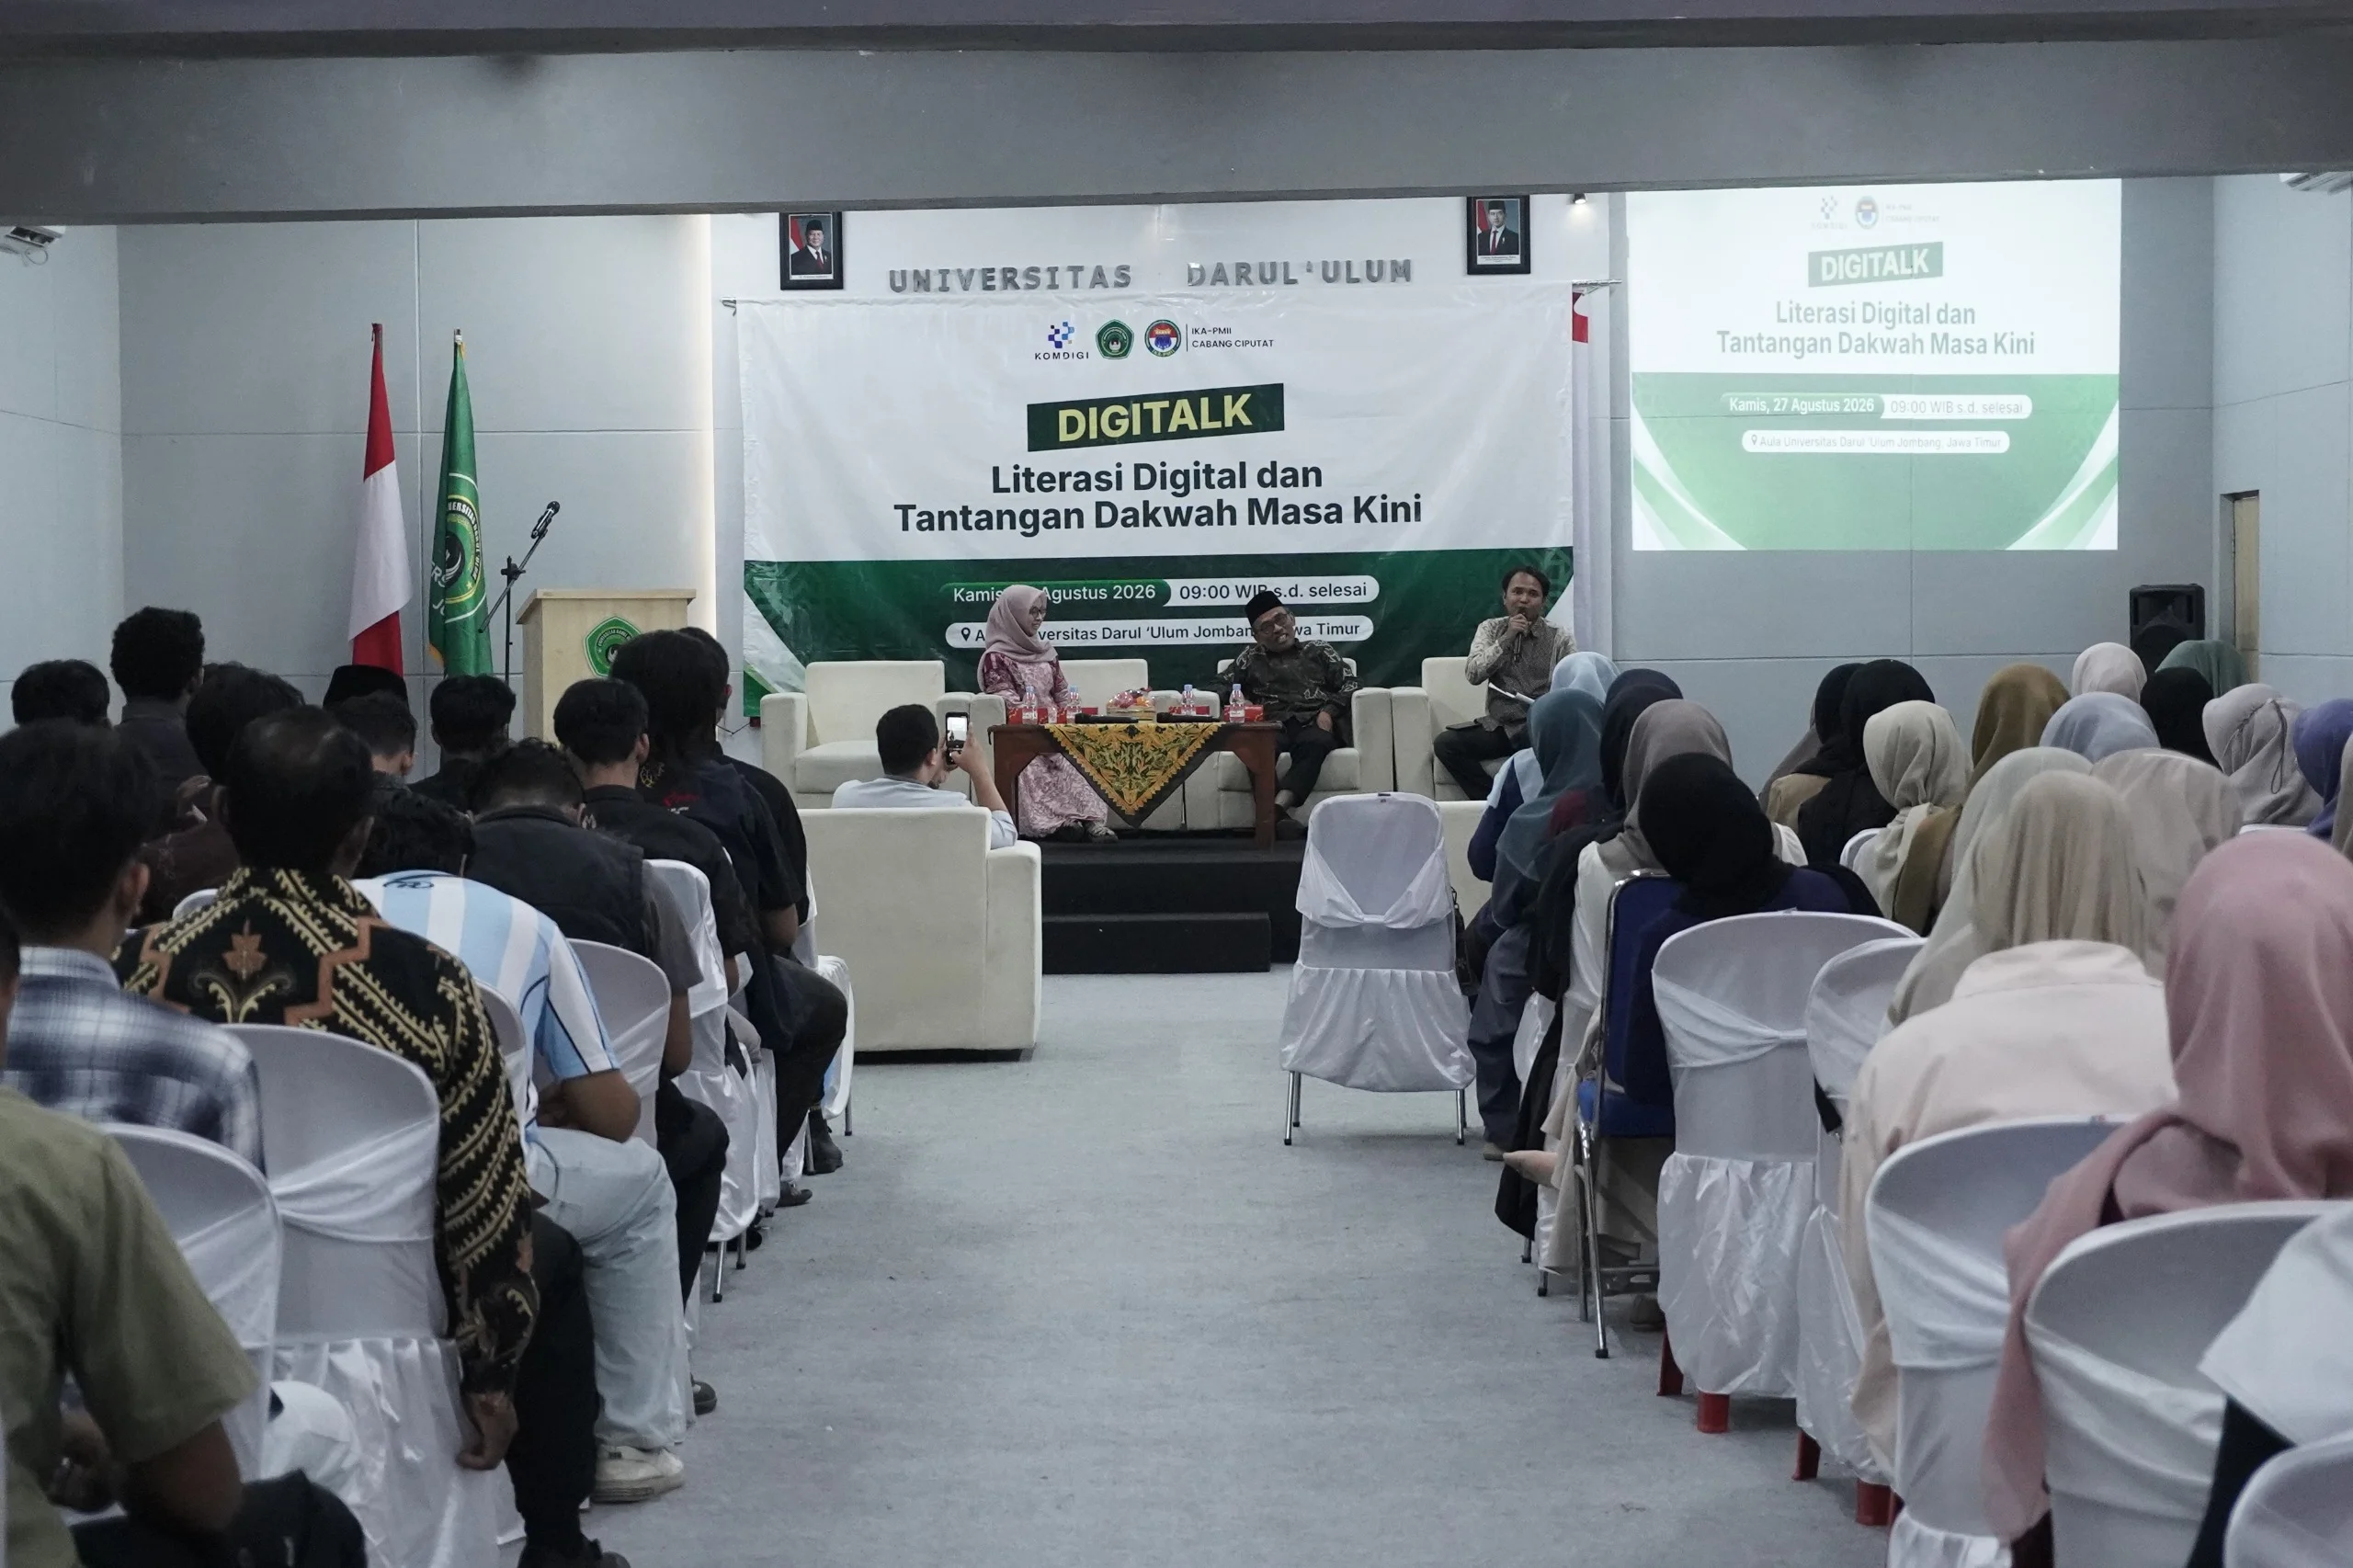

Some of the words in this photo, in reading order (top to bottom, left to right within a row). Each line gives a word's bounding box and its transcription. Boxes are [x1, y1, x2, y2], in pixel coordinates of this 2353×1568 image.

[1820, 248, 1929, 281] DIGITALK
[890, 265, 1131, 293] UNIVERSITAS
[1777, 300, 1855, 324] Literasi
[1862, 301, 1929, 330] Digital
[1937, 302, 1974, 324] dan
[1191, 327, 1232, 335] IKA-PMII
[1191, 339, 1233, 348] CABANG
[1234, 339, 1274, 347] CIPUTAT
[1717, 330, 1832, 359] Tantangan
[1839, 331, 1924, 354] Dakwah
[1931, 333, 1986, 354] Masa
[1995, 332, 2034, 354] Kini
[1034, 352, 1089, 360] KOMDIGI
[1730, 397, 1769, 414] Kamis,
[1774, 398, 1788, 411] 27
[1791, 398, 1840, 415] Agustus
[1844, 398, 1874, 412] 2026
[1891, 401, 1926, 414] 09:00
[1930, 401, 1953, 413] WIB
[1056, 392, 1254, 443] DIGITALK
[1759, 437, 1780, 446] Aula
[1784, 437, 1836, 447] Universitas
[1947, 437, 1971, 447] Jawa
[1975, 437, 2001, 447] Timur
[993, 462, 1122, 493] Literasi
[1134, 460, 1246, 497] Digital
[1257, 460, 1322, 488] dan
[894, 505, 1084, 537] Tantangan
[1096, 499, 1236, 528] Dakwah
[1248, 498, 1342, 525] Masa
[1354, 494, 1421, 523] Kini
[1113, 585, 1155, 598] 2026
[1180, 585, 1229, 599] 09:00
[1273, 584, 1303, 598] s.d.
[1310, 583, 1366, 597] selesai
[1039, 626, 1097, 641] versitas
[1103, 627, 1141, 639] Darul
[1317, 623, 1359, 635] Timur
